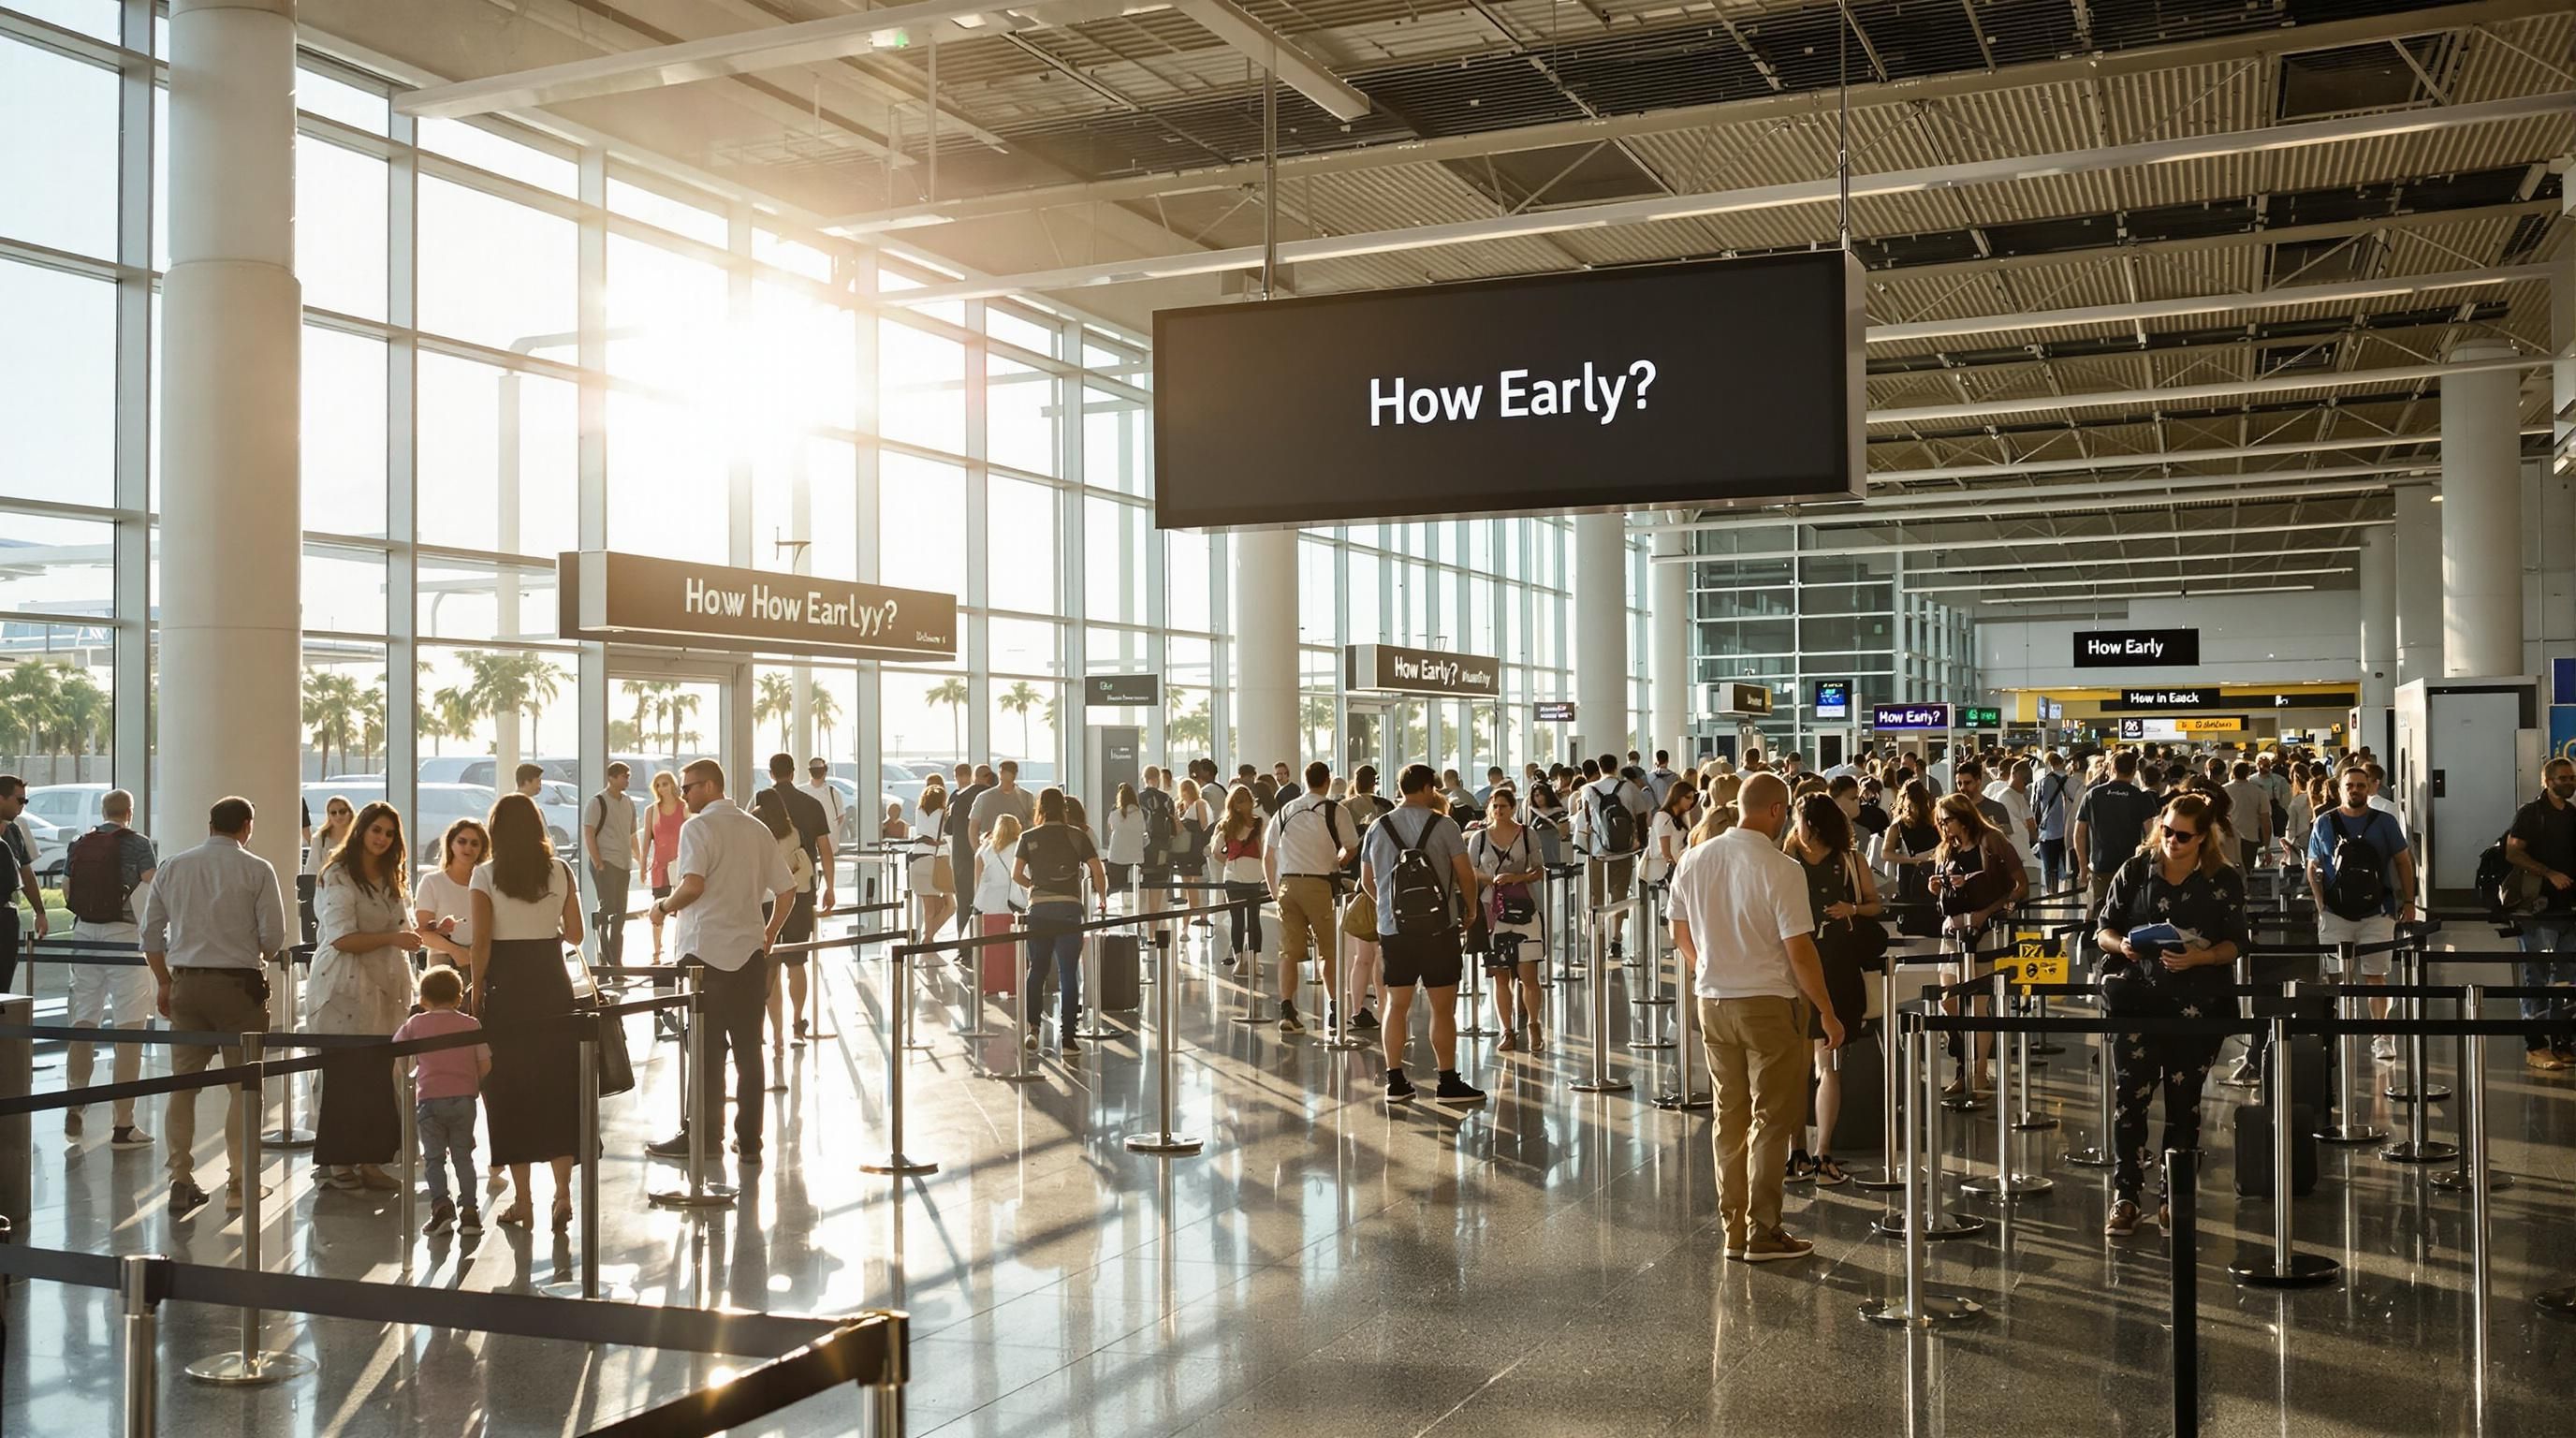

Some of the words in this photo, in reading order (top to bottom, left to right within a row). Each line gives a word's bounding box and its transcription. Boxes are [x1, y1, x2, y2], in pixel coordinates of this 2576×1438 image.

[1370, 377, 1483, 426] How
[1500, 360, 1657, 425] Early?
[752, 583, 802, 623] How
[2087, 638, 2121, 655] How
[2126, 638, 2163, 658] Early
[1395, 655, 1419, 679] How
[1421, 659, 1457, 685] Early?
[2130, 693, 2154, 704] How
[1879, 711, 1904, 724] How
